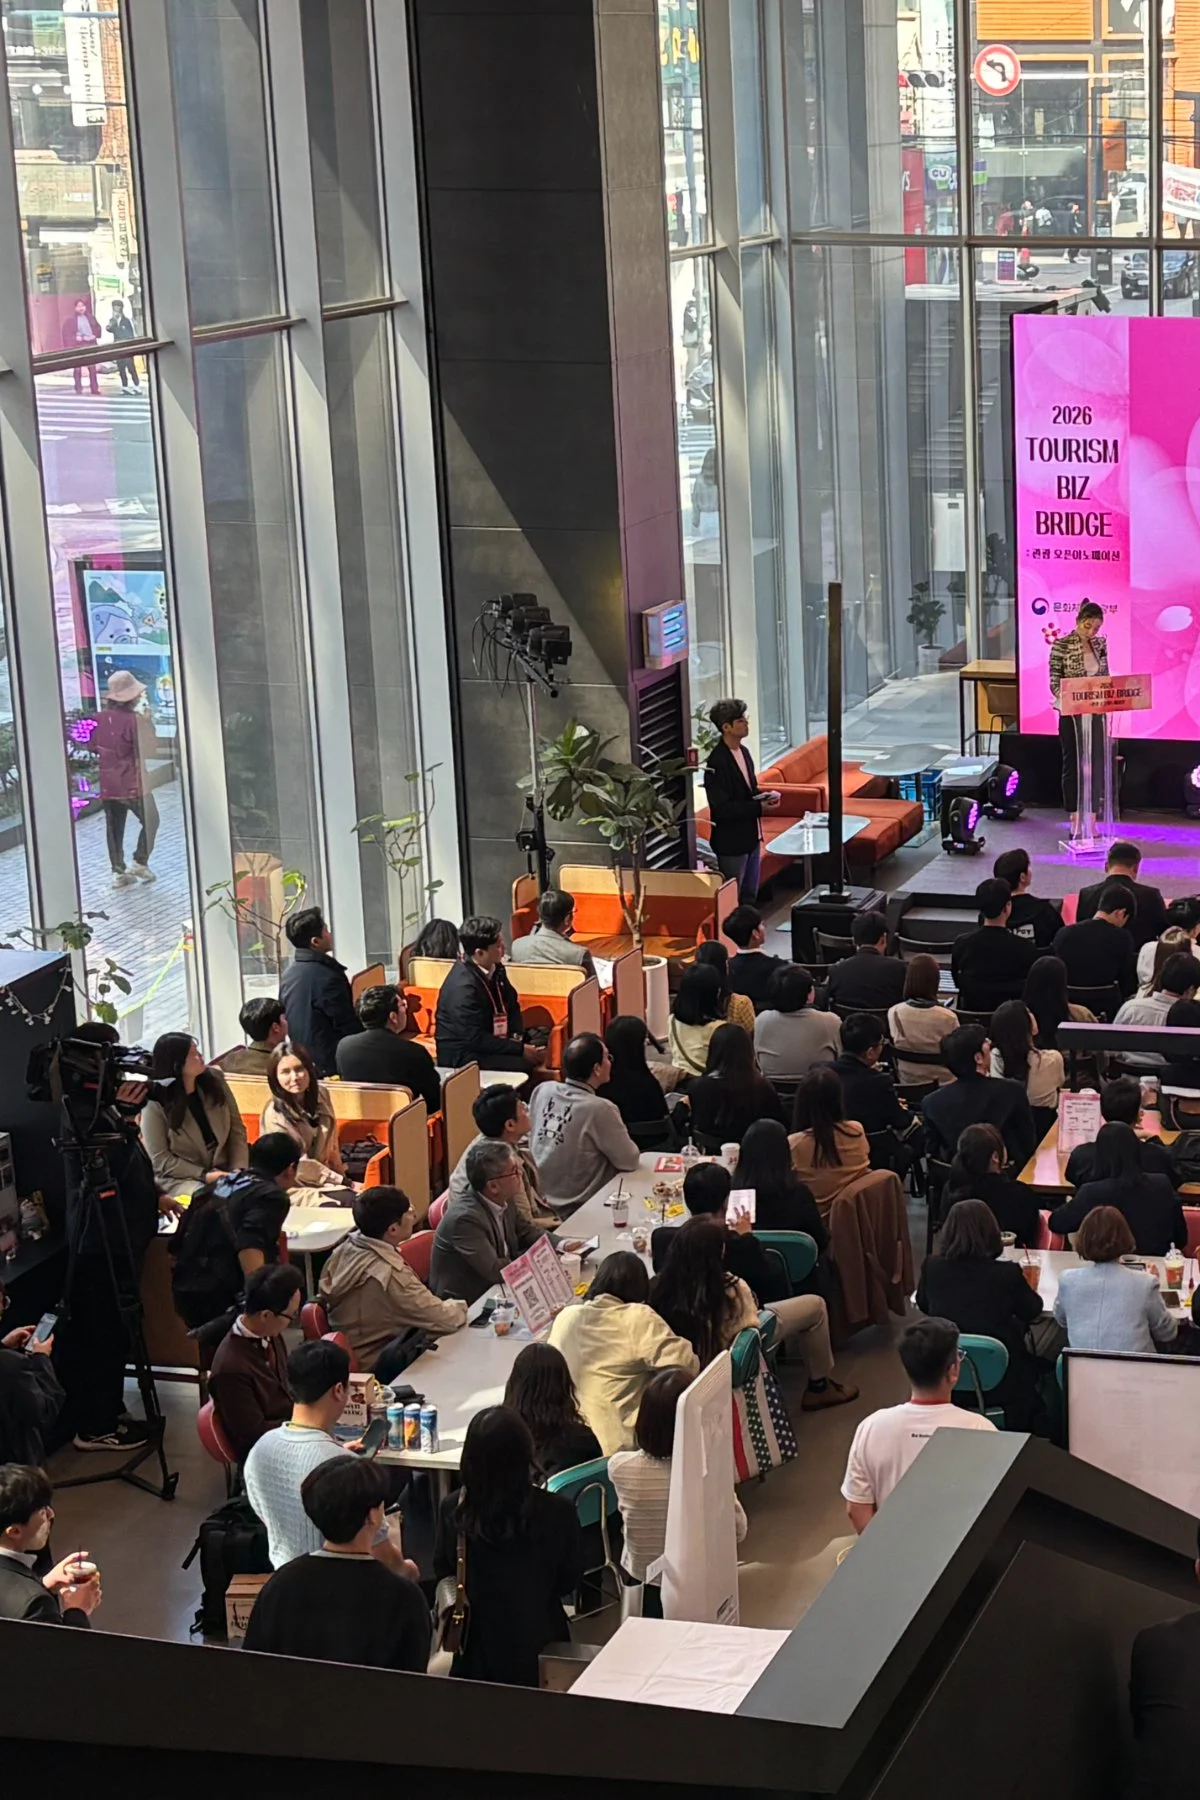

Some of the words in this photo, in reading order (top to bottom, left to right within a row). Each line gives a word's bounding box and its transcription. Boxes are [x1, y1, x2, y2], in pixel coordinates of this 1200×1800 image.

[931, 168, 947, 178] CU
[1052, 405, 1092, 425] 2026
[1025, 437, 1119, 464] TOURISM
[1056, 475, 1091, 500] BIZ
[1035, 511, 1113, 537] BRIDGE
